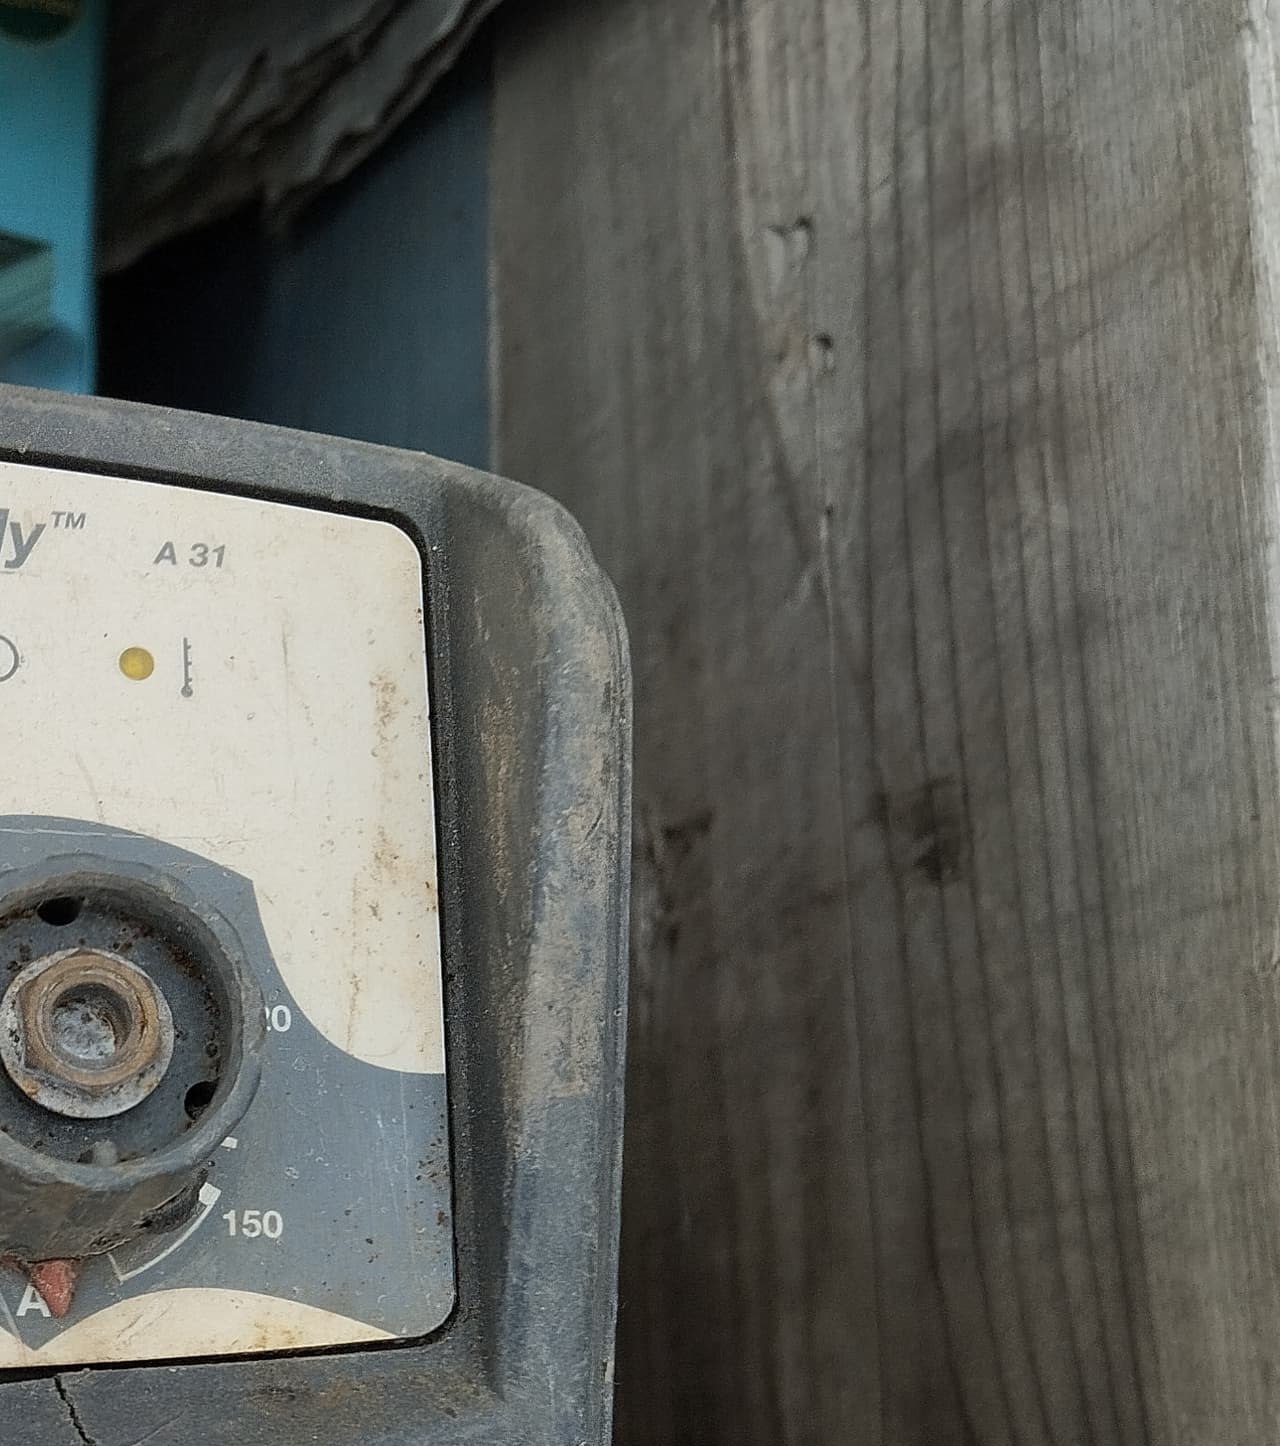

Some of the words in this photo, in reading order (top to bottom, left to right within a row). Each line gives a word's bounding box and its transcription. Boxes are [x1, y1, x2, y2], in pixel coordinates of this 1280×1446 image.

[153, 541, 178, 566] A
[189, 543, 227, 569] 31
[264, 1004, 292, 1033] 0
[223, 1210, 284, 1240] 150
[16, 1283, 52, 1318] A
